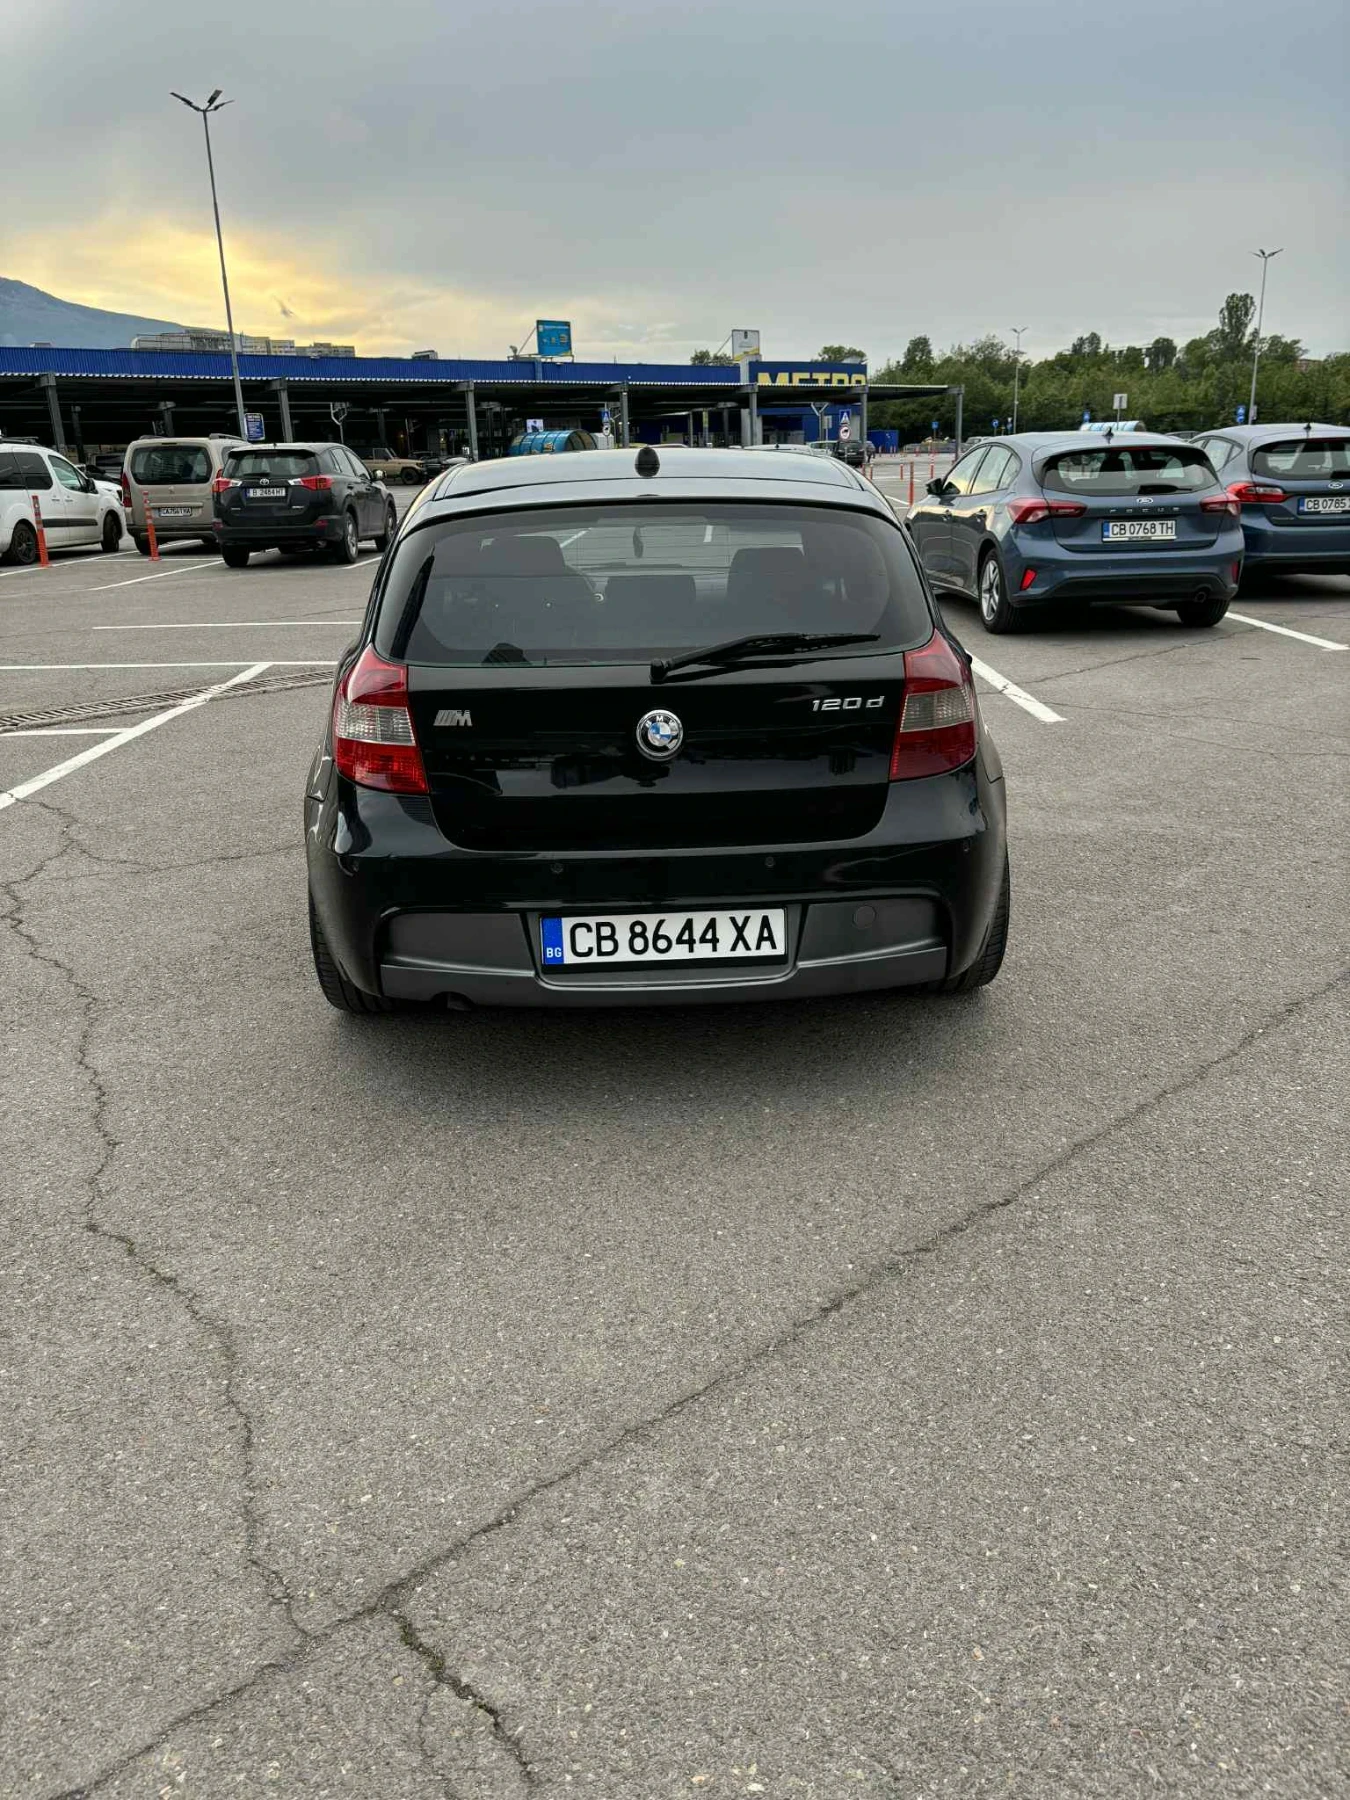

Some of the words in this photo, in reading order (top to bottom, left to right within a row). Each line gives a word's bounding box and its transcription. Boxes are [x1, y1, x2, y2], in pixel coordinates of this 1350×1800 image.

[1306, 499, 1320, 510] CB
[1111, 523, 1127, 536] CB
[1129, 522, 1157, 535] 0768
[1158, 522, 1174, 534] TH
[546, 947, 562, 957] BG
[569, 922, 619, 957] CB
[628, 917, 719, 955] 8644
[729, 915, 777, 952] XA
